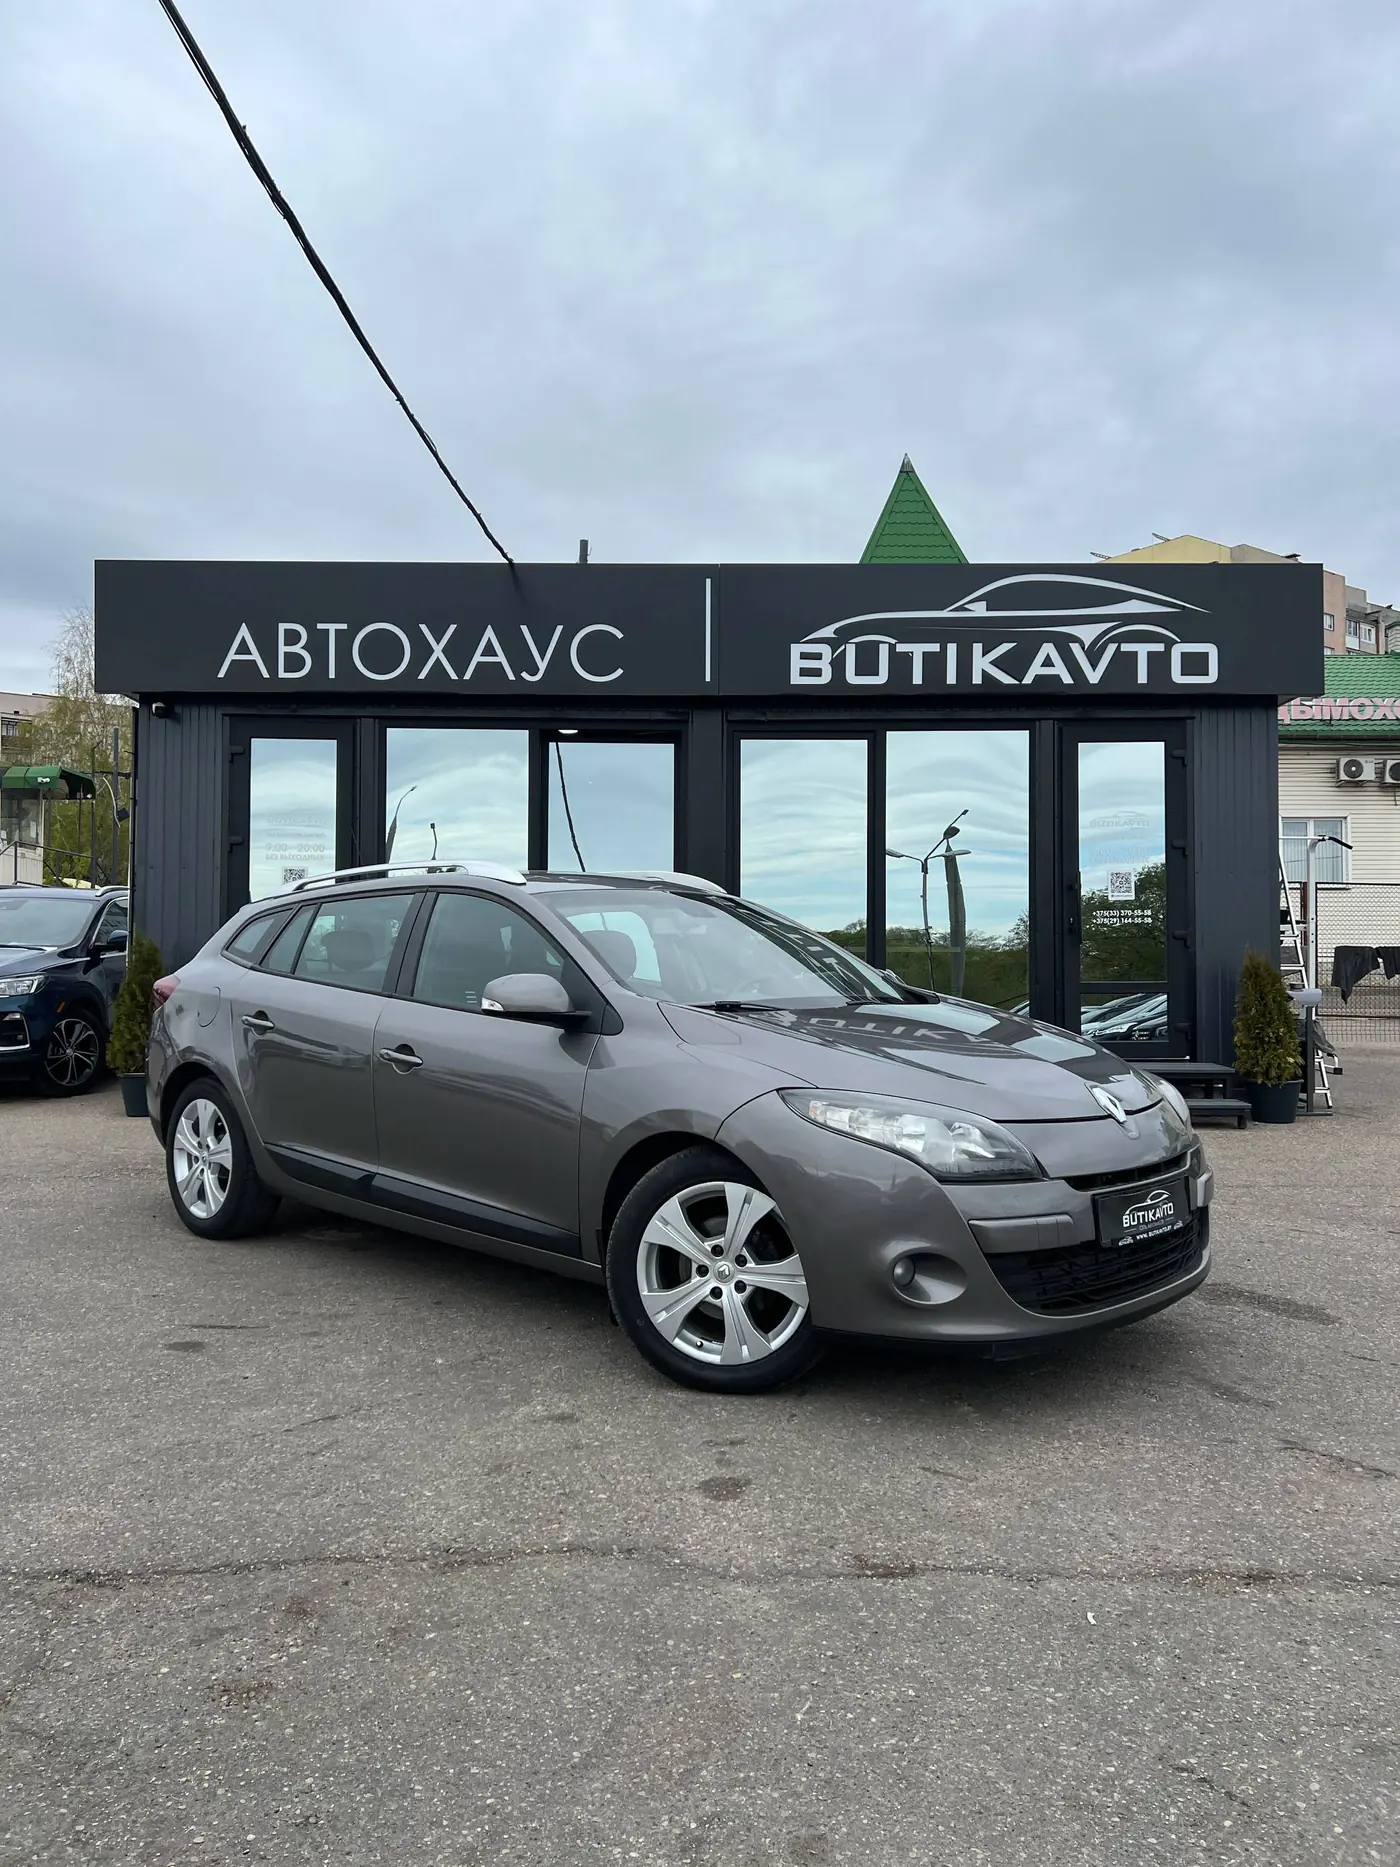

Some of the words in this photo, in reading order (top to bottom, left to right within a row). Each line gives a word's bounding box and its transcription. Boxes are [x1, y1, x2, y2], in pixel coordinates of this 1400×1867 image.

[217, 622, 624, 683] АВТОХАУС
[790, 642, 1219, 685] BUTIKAVTO
[1278, 697, 1400, 725] ЫМОХ
[1122, 1202, 1174, 1228] BUTIKAVTO
